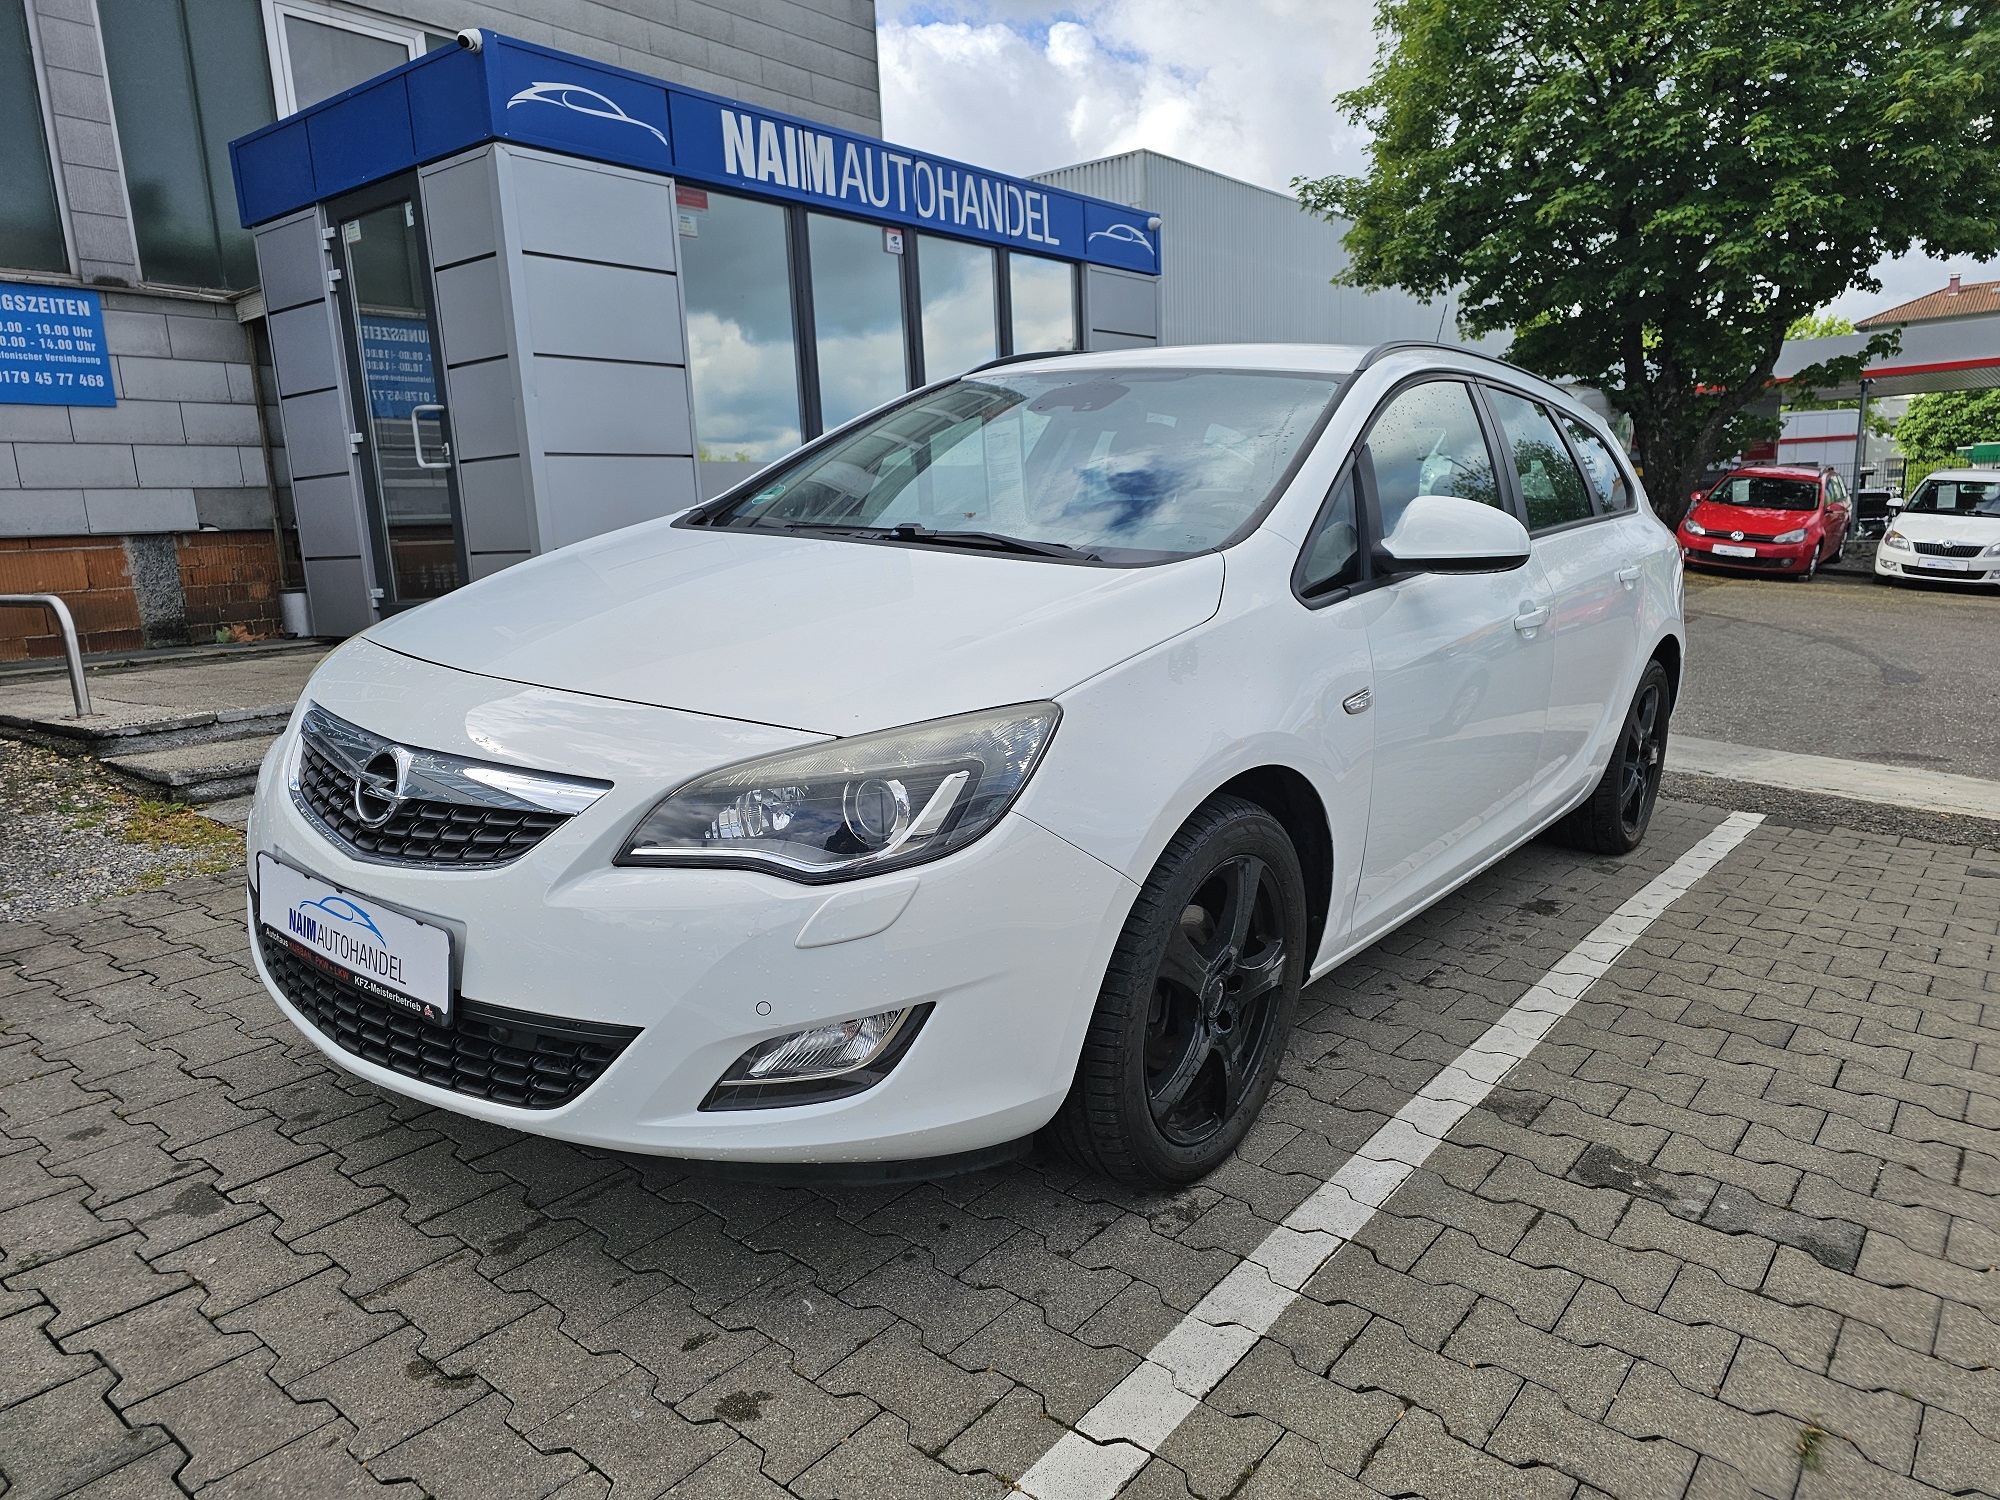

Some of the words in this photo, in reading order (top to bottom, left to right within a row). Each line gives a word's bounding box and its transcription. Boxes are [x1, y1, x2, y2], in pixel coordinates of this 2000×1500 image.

[721, 109, 837, 197] NAIM
[840, 142, 1060, 246] AUTOHANDEL
[0, 294, 91, 317] GSZEITEN
[36, 323, 69, 336] 19.00
[73, 326, 93, 338] Uhr
[39, 338, 73, 350] 14.00
[76, 341, 96, 352] Uhr
[45, 353, 101, 365] Vereinbarung
[35, 371, 52, 385] 45
[56, 373, 73, 386] 77
[79, 374, 104, 387] 468
[289, 907, 316, 944] NAIM
[317, 923, 407, 986] AUTOHANDEL
[265, 927, 289, 947] Autohaus
[334, 966, 349, 980] LKW
[354, 975, 422, 1012] KFZ-Meisterbetrieb
